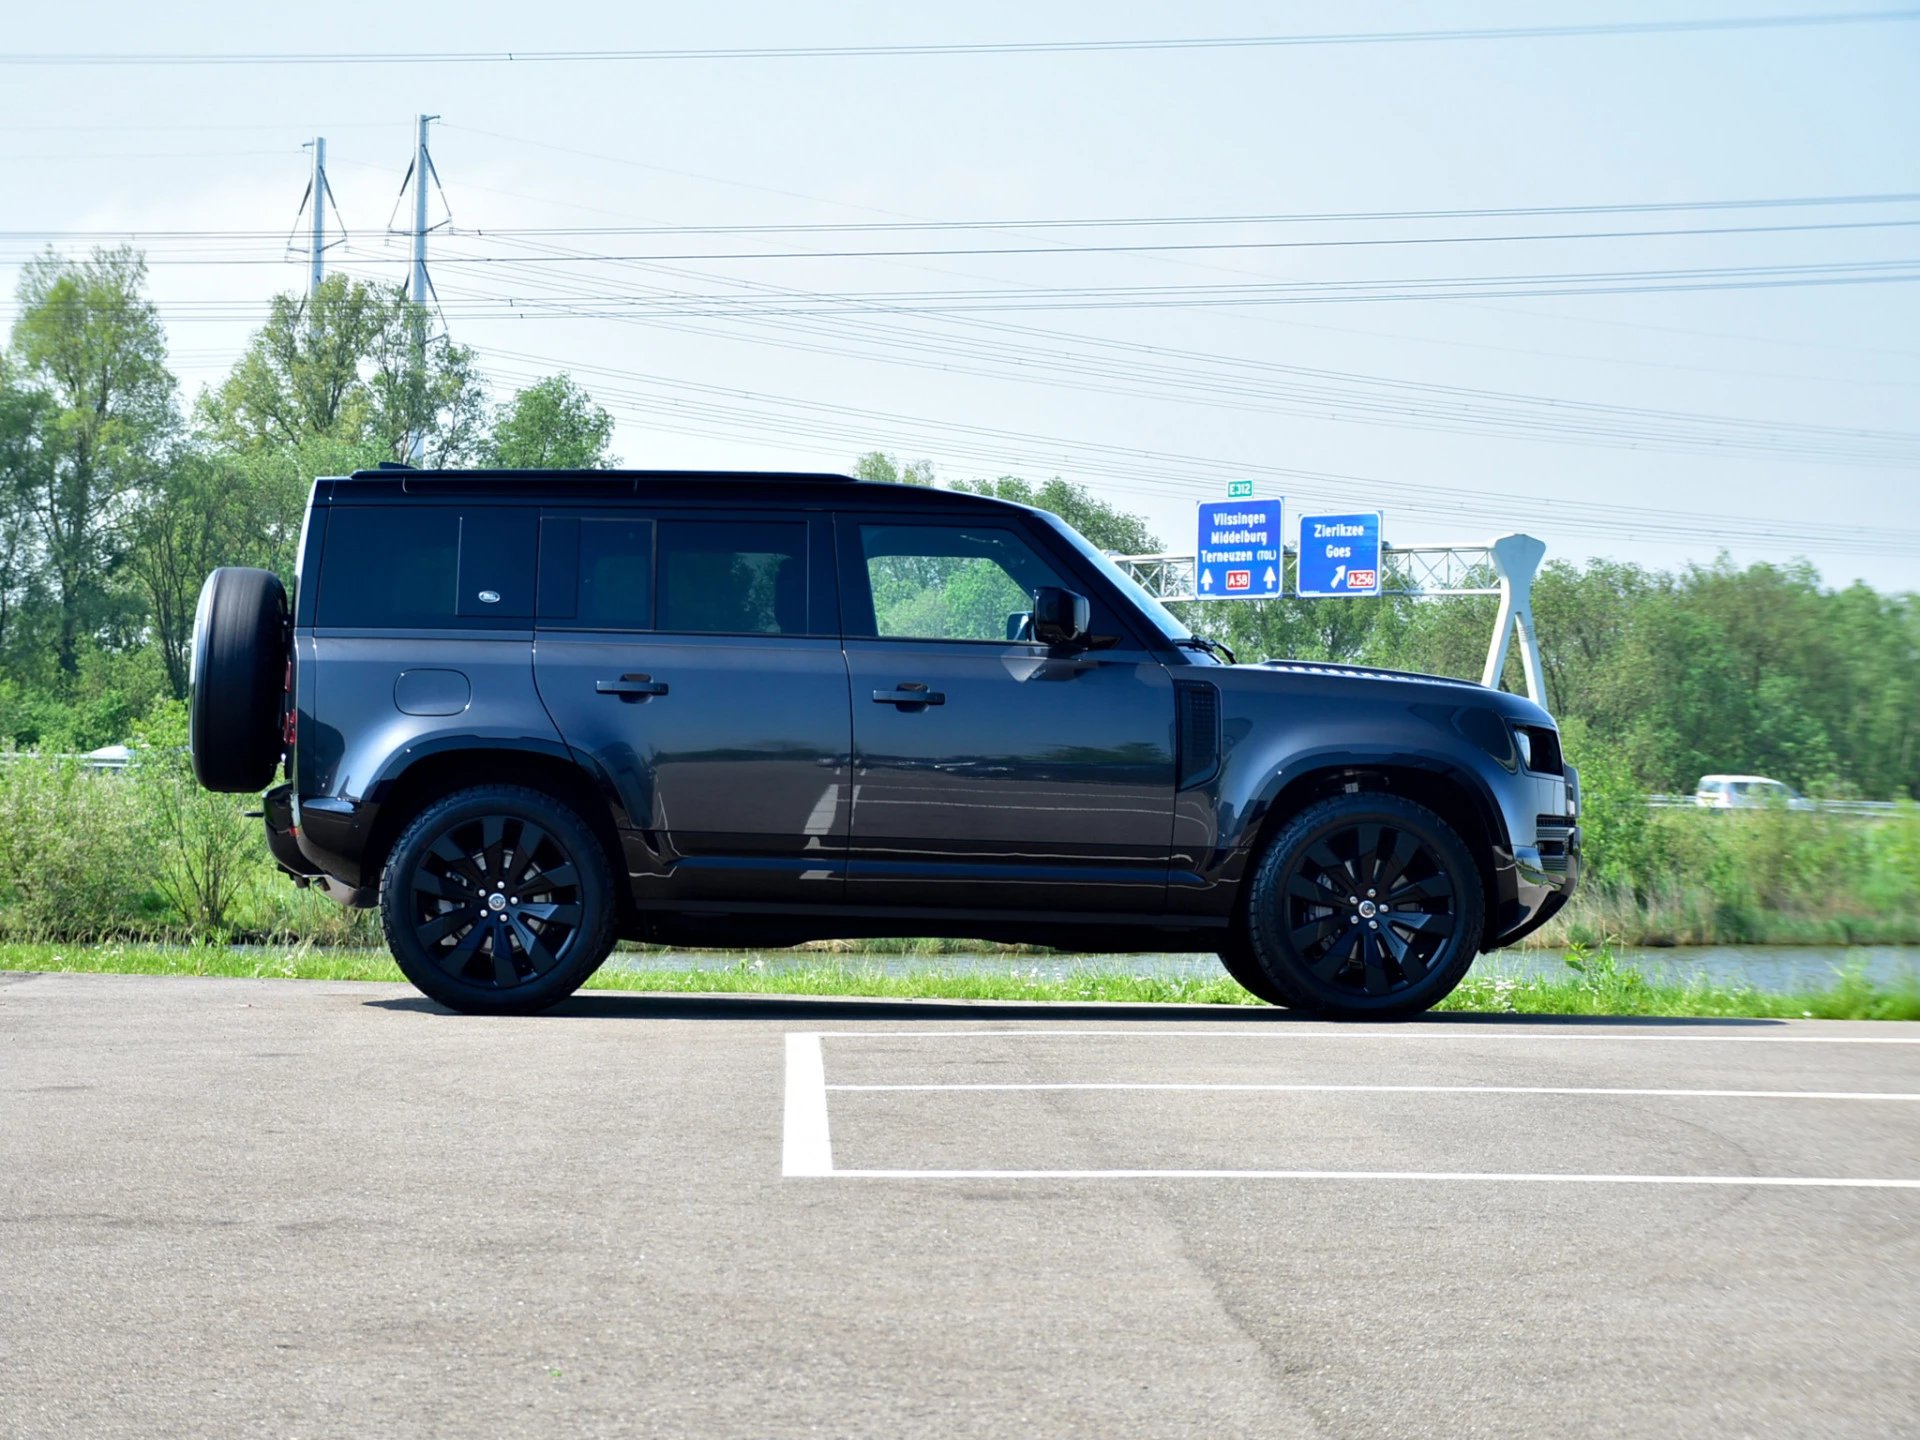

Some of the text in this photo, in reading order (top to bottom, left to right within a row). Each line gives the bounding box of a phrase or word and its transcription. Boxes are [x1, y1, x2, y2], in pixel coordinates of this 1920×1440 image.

[1229, 483, 1251, 495] E312
[1213, 512, 1266, 528] Vlissingen
[1314, 523, 1364, 538] Zierikzee
[1211, 530, 1267, 546] Middelburg
[1201, 549, 1277, 563] Terneuzen (TOL)
[1325, 544, 1351, 558] Goes
[1228, 574, 1248, 586] A58
[1349, 573, 1373, 586] A256
